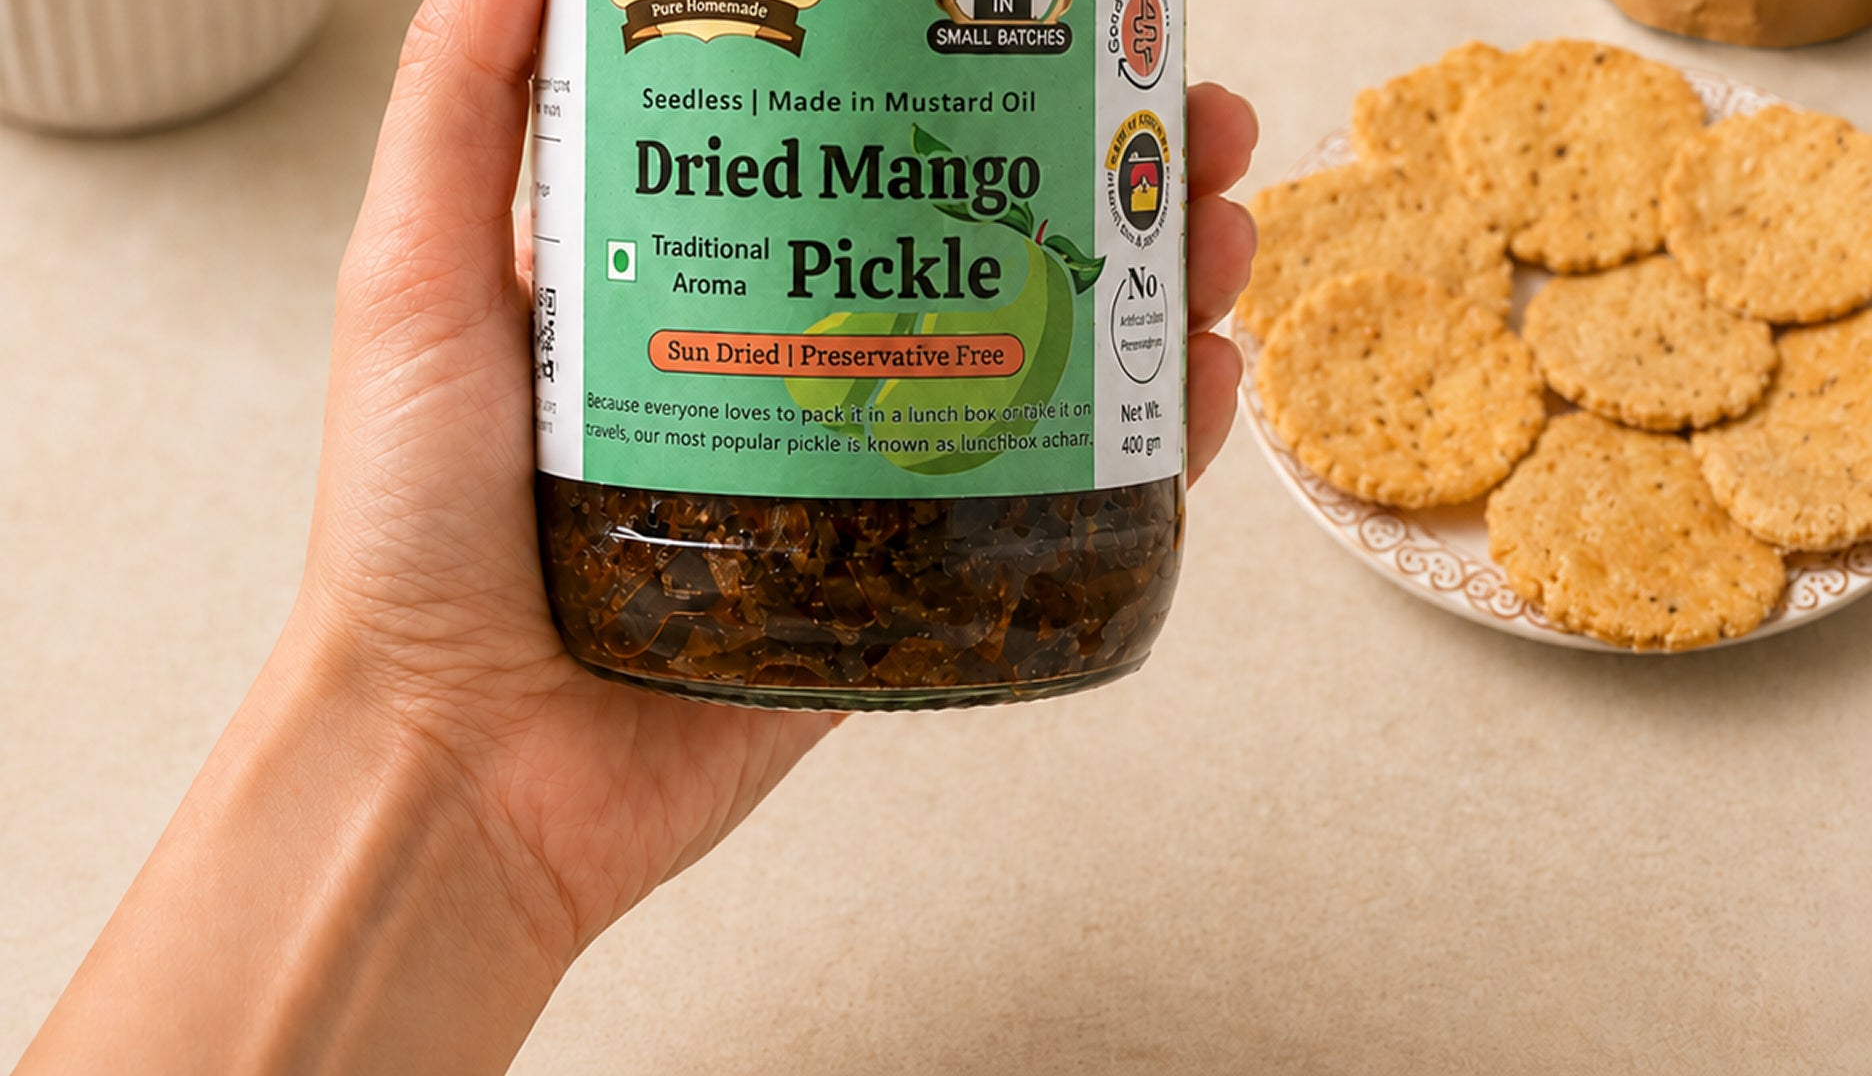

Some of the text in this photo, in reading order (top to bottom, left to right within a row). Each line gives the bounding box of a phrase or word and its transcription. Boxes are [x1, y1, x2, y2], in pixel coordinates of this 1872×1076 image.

[936, 27, 1066, 46] SMALL BATCHES
[642, 88, 744, 112] Seedless
[768, 91, 842, 113] Made
[851, 91, 875, 112] in
[885, 91, 993, 113] Mustard
[1002, 91, 1036, 113] Oil
[635, 135, 803, 199] Dried
[818, 144, 1041, 216] Mango
[652, 234, 770, 260] Traditional
[787, 236, 1002, 300] Pickle
[672, 272, 747, 296] Aroma
[1127, 266, 1158, 301] No
[667, 340, 710, 362] Sun
[716, 342, 780, 365] Dried
[800, 345, 950, 367] Preservative
[955, 345, 1004, 367] Free
[587, 392, 1092, 426] Because everyone loves to pack it in a lunch box or take it on
[1121, 404, 1142, 423] Net
[586, 423, 630, 444] travels,
[634, 428, 660, 444] our
[665, 431, 706, 448] most
[711, 433, 781, 454] popular
[787, 435, 841, 455] pickle
[847, 436, 861, 452] is
[867, 435, 929, 453] known
[935, 439, 956, 453] as
[961, 433, 1037, 452] lunchbox
[1121, 435, 1143, 454] 400
